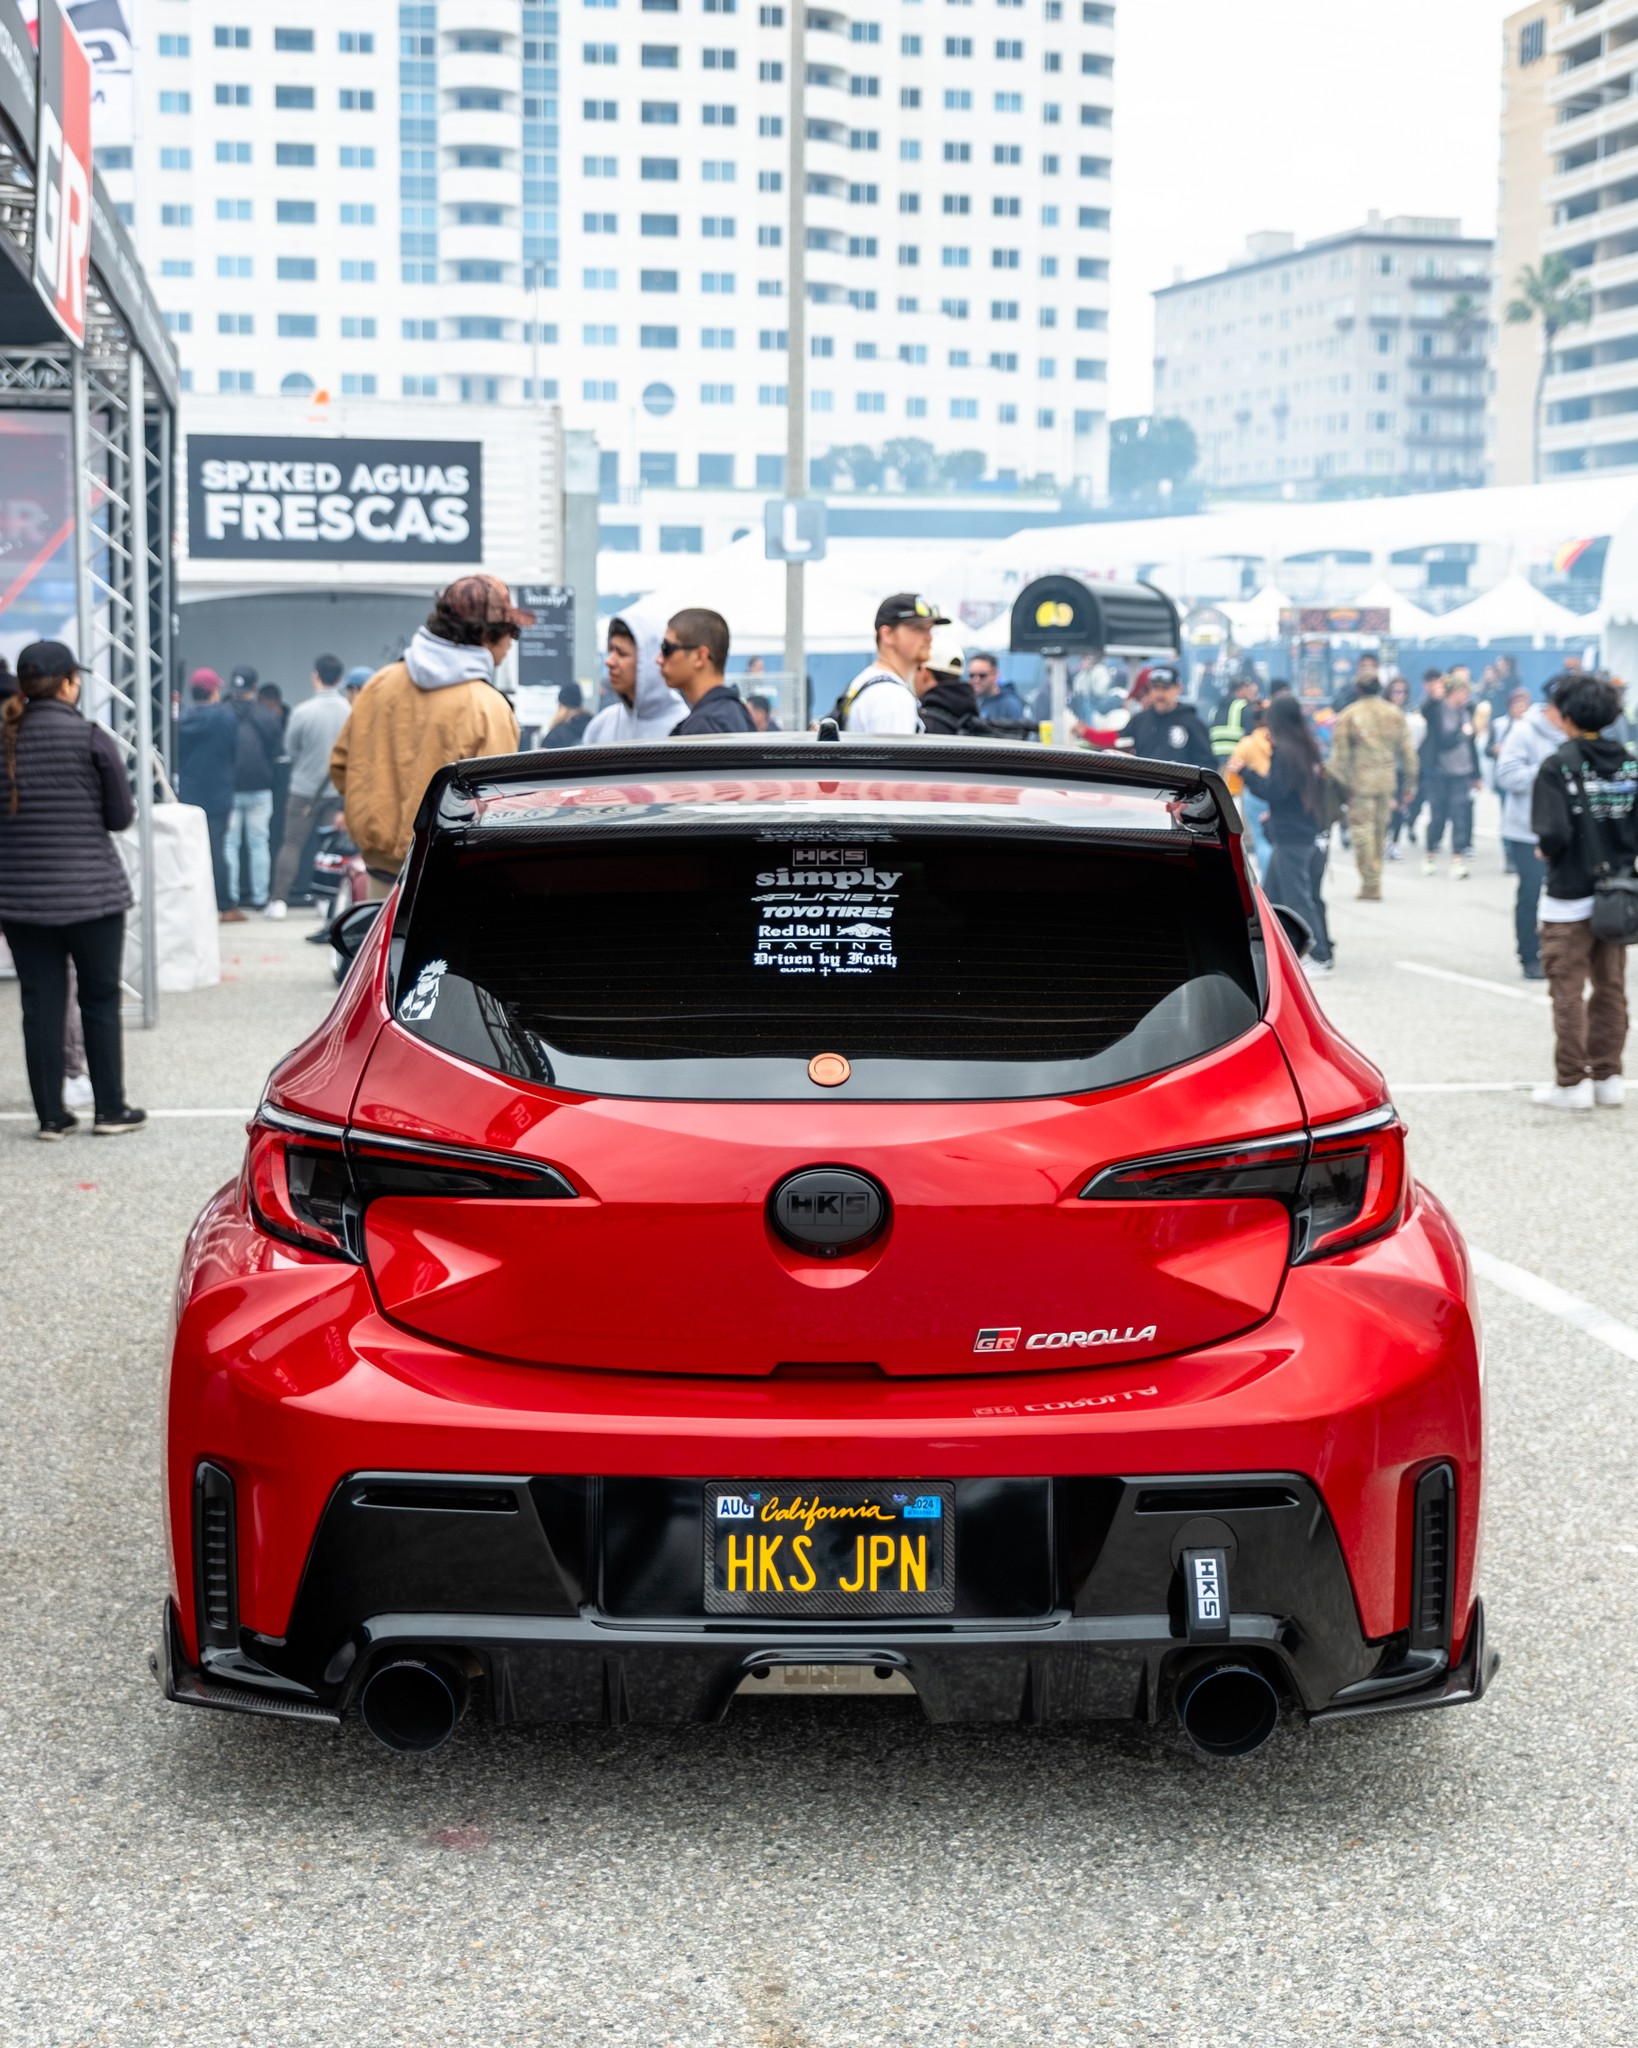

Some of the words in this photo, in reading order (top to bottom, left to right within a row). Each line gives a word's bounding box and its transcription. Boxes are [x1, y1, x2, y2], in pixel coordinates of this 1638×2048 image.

[37, 103, 90, 323] GR
[201, 459, 342, 492] SPIKED
[348, 463, 470, 495] AGUAS
[205, 492, 471, 544] FRESCAS
[783, 503, 812, 553] L
[795, 850, 865, 862] HKS
[755, 867, 903, 890] simply
[765, 892, 900, 902] PURIST
[762, 905, 825, 918] TOYO
[825, 905, 895, 918] TIRES
[758, 924, 794, 937] Red
[796, 924, 831, 937] Bull
[758, 942, 893, 951] RACING
[753, 952, 813, 965] Driven
[819, 952, 841, 967] by
[846, 952, 898, 968] Faith
[790, 1194, 867, 1215] HKS
[1024, 1325, 1158, 1350] COROLLA
[761, 1496, 896, 1531] California
[727, 1534, 817, 1592] HKS
[839, 1534, 927, 1592] JPN
[1200, 1561, 1218, 1617] HKS
